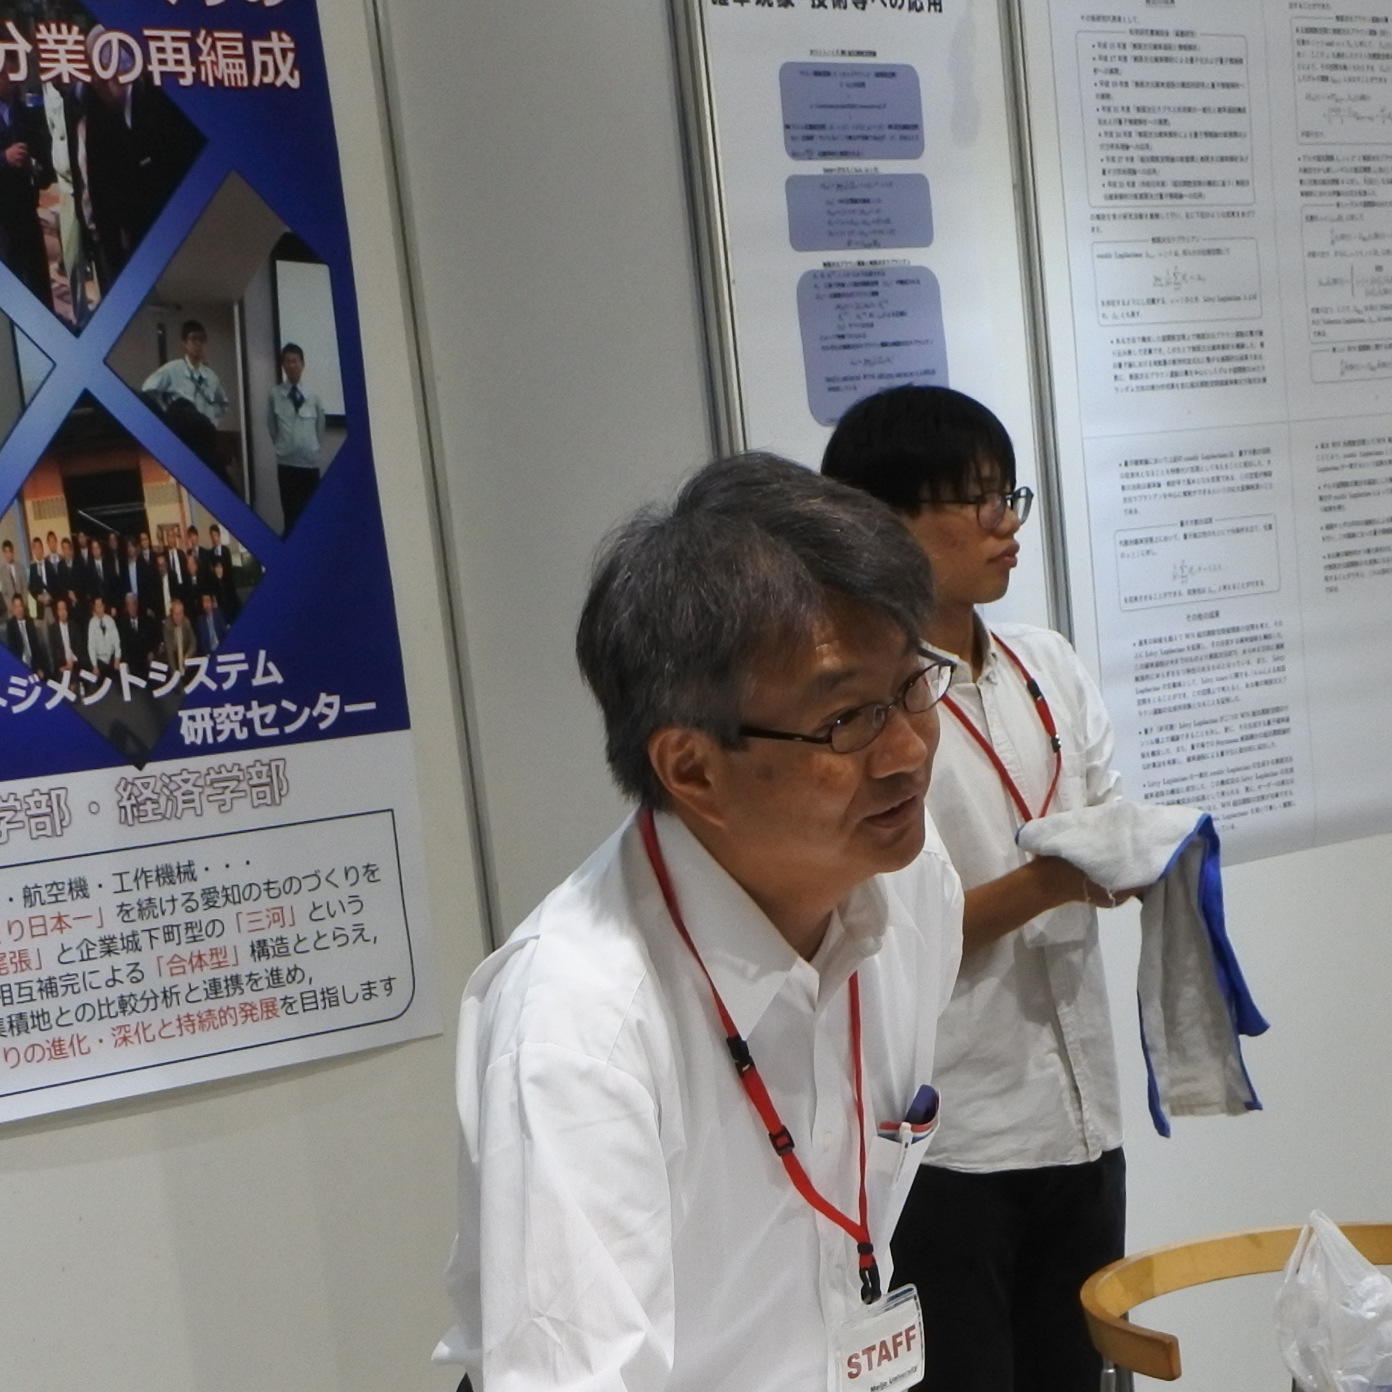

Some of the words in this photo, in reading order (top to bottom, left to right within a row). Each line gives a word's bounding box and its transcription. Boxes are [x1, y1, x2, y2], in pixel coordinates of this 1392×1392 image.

[177, 696, 378, 746] 研究センター
[846, 1325, 917, 1379] STAFF
